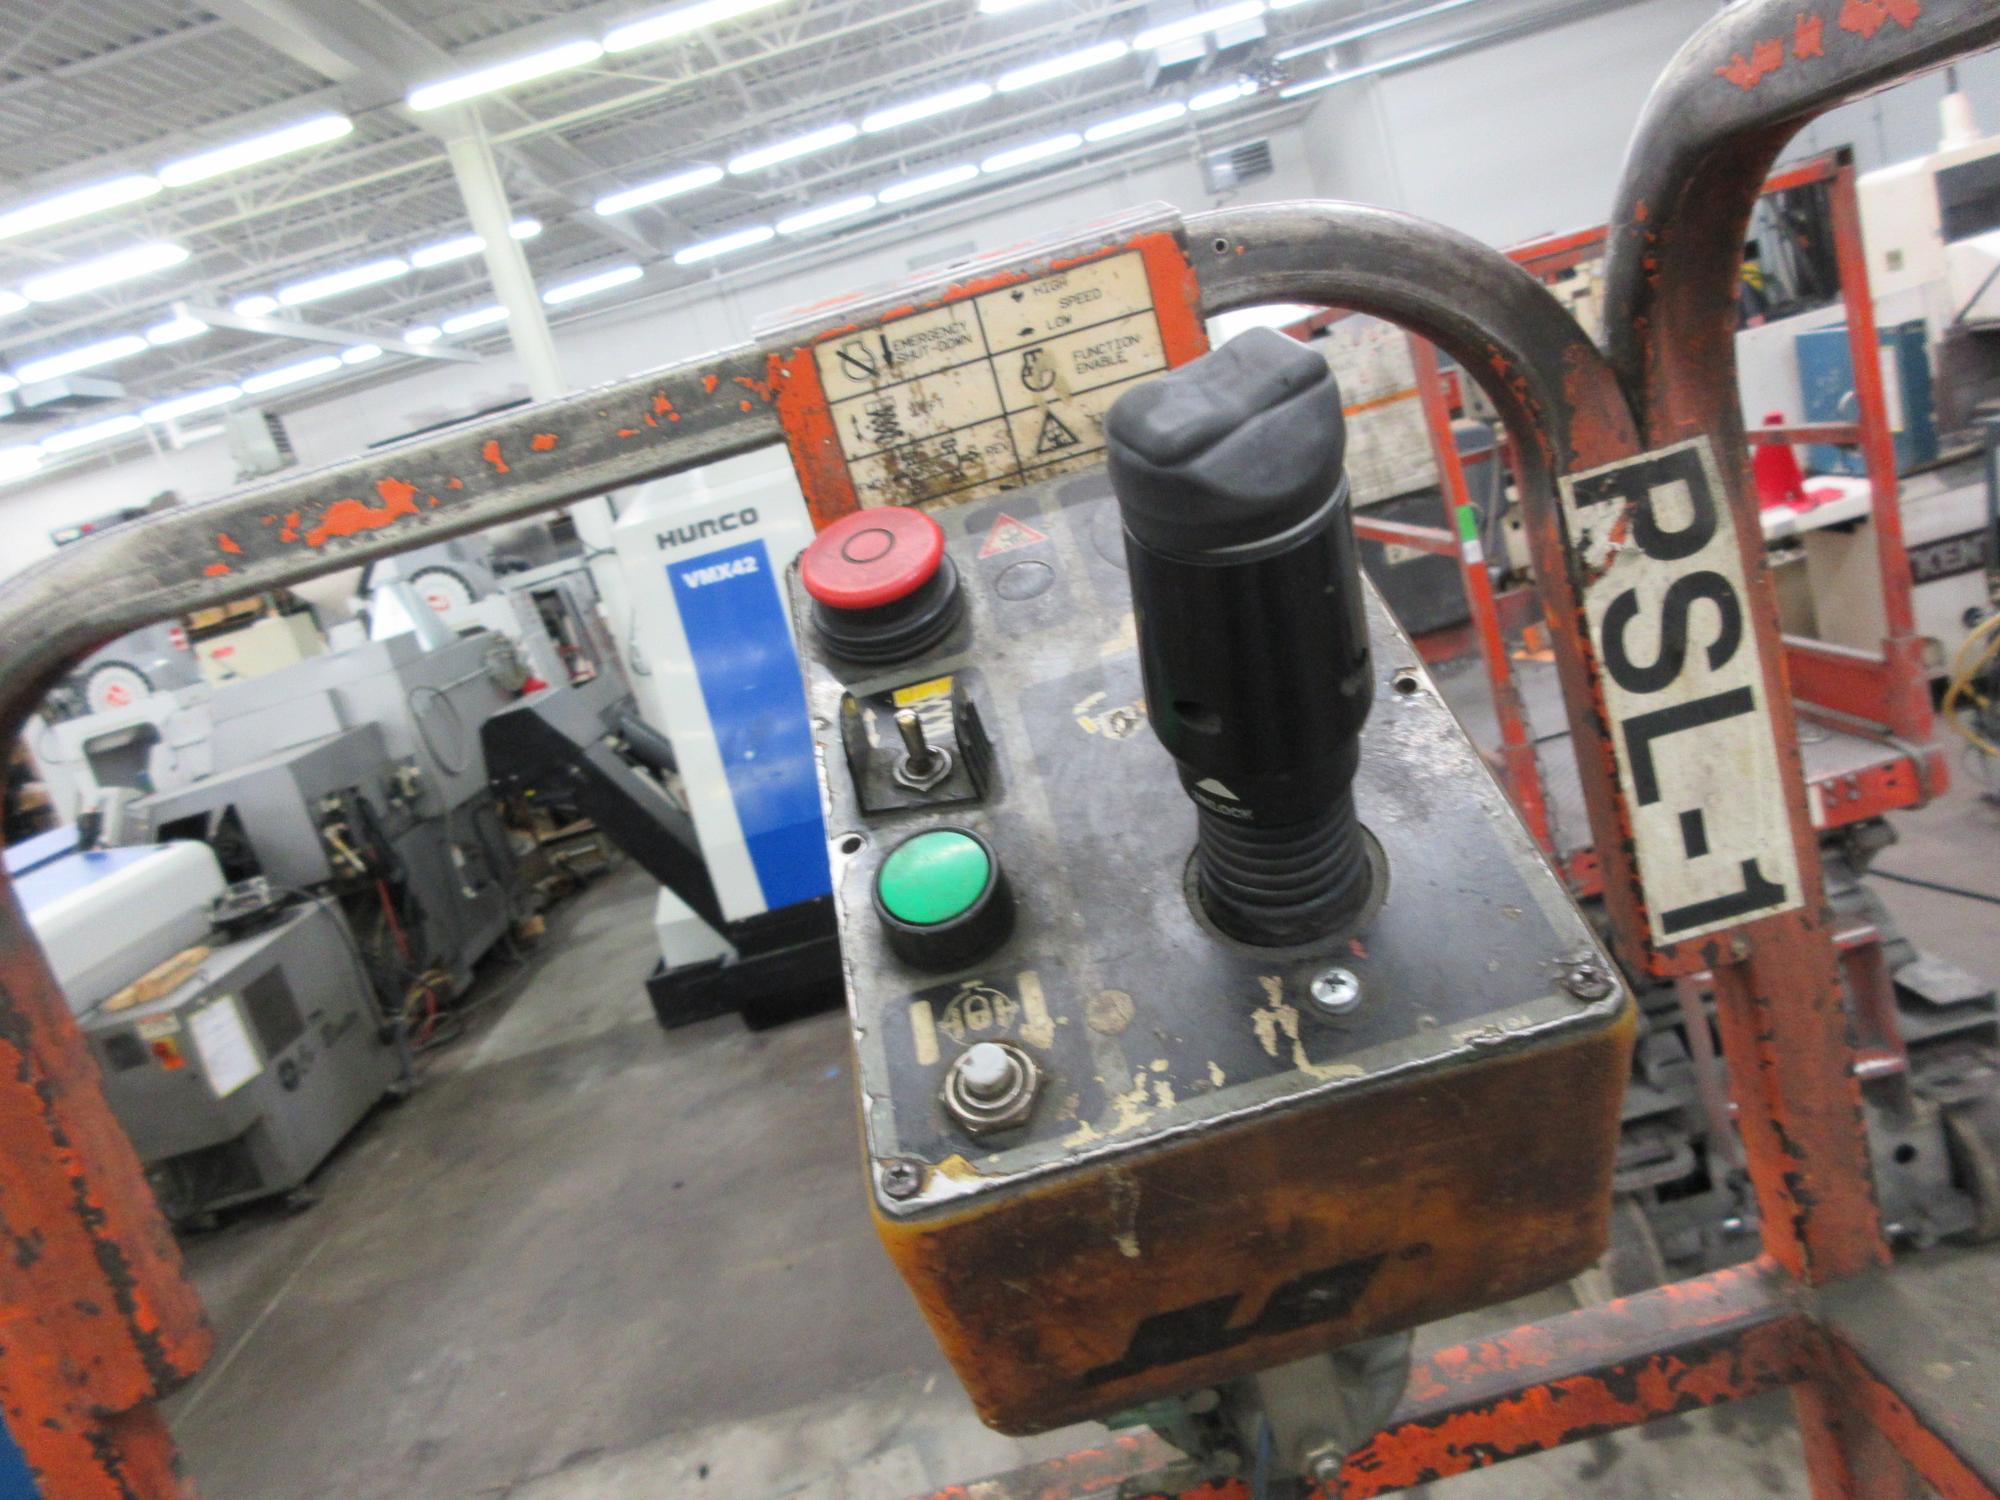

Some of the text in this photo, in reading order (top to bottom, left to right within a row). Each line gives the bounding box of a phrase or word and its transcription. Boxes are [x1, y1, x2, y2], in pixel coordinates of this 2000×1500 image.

[1033, 276, 1068, 296] HIGH
[1059, 288, 1103, 309] SPEED
[1046, 312, 1072, 331] LOW
[891, 320, 967, 353] EMERGENCY
[1073, 335, 1141, 362] FUNCTION
[1076, 352, 1128, 375] ENABLE
[656, 507, 759, 550] HURCO
[681, 556, 760, 590] VMX42
[1573, 446, 1787, 936] PSL-1
